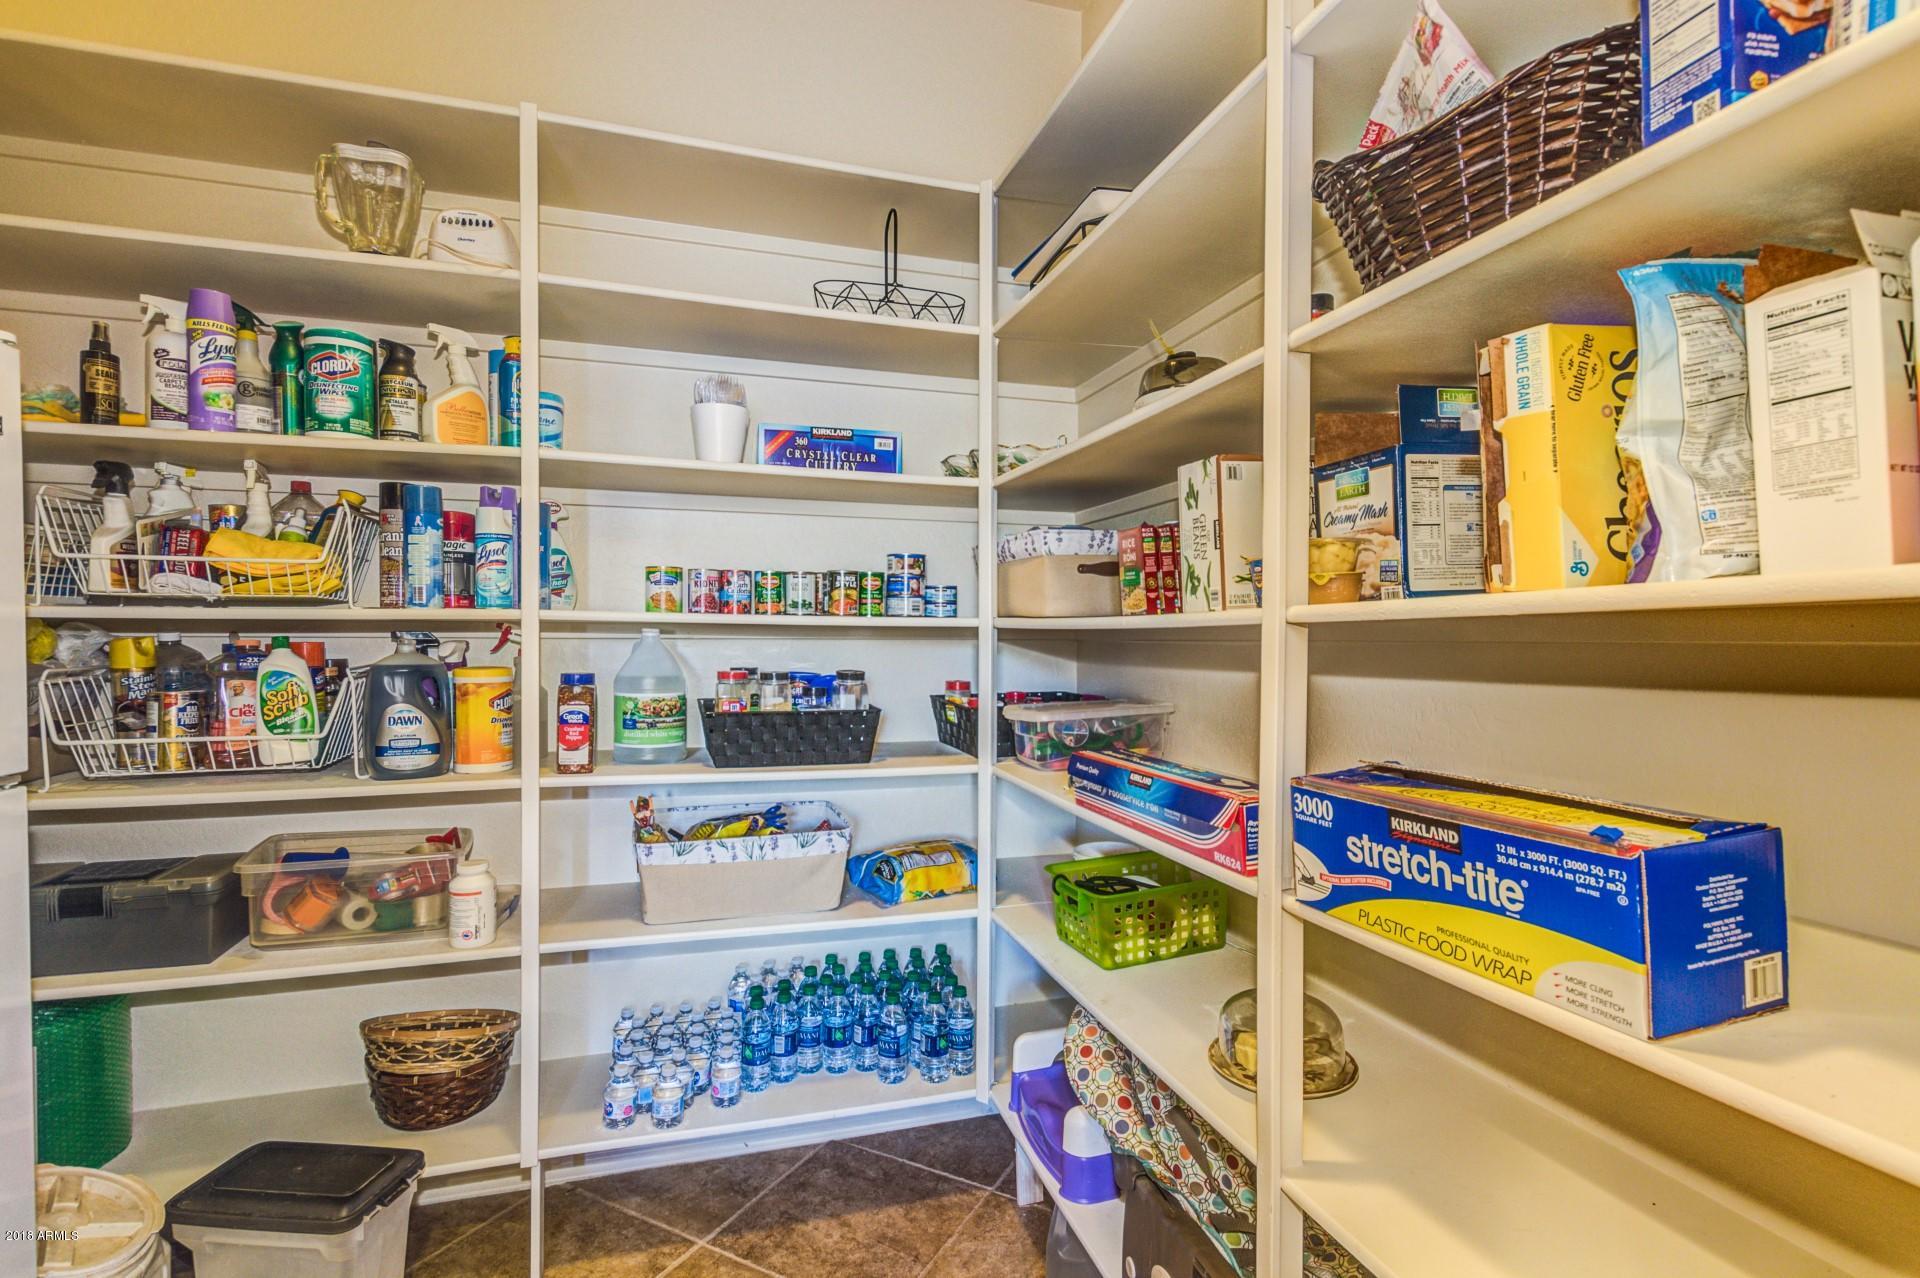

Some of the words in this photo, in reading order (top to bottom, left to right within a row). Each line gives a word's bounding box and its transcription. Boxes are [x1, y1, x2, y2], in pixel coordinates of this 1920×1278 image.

[1361, 122, 1381, 147] Pack
[1766, 304, 1813, 319] Nutrition
[1815, 293, 1848, 305] Facts
[198, 337, 236, 360] Lyso
[1515, 333, 1529, 374] WHOLE
[1577, 333, 1596, 359] Free
[311, 359, 355, 375] CLOROX
[164, 383, 187, 391] REMOV
[309, 381, 359, 393] DISINFECTING
[381, 379, 414, 388] UST-OLEUM
[1567, 360, 1590, 403] Gluten
[320, 387, 345, 396] WIPES
[381, 386, 416, 397] NIVERSAL
[1517, 375, 1531, 411] GRAIN
[794, 436, 808, 446] 360
[812, 427, 853, 437] KIRKLAND
[786, 448, 836, 462] CRYSTAL
[841, 451, 877, 463] CLEAR
[806, 458, 858, 472] CUTLERY
[1340, 486, 1366, 497] EARTH
[1323, 511, 1359, 531] Creamy
[1359, 501, 1389, 520] Mash
[176, 529, 191, 551] STEEL
[382, 527, 404, 542] rani
[1122, 538, 1136, 548] RICE
[1192, 517, 1201, 560] BEANS
[1199, 513, 1208, 561] GREEN
[383, 542, 403, 556] lean
[477, 541, 508, 563] Lysol
[1123, 553, 1137, 563] RONI
[551, 556, 567, 568] sol
[693, 579, 720, 588] KIDNE
[121, 674, 153, 686] Stainl
[129, 682, 154, 692] Ste
[266, 680, 301, 706] Soft
[228, 707, 256, 718] Cle
[263, 692, 309, 721] Scrub
[494, 700, 513, 711] CLO
[387, 715, 423, 727] DAWN
[562, 712, 584, 721] Great
[1088, 765, 1100, 777] Quality
[1293, 792, 1334, 822] 3000
[1295, 812, 1318, 826] SQUARE
[1318, 817, 1333, 829] FEET
[1390, 815, 1460, 845] KIRKLAND
[1213, 850, 1242, 872] RK624
[1495, 843, 1506, 854] 12
[1526, 850, 1548, 863] 3000
[1548, 855, 1562, 867] FT.
[1562, 858, 1589, 873] (3000
[1590, 864, 1607, 878] SQ.
[1607, 868, 1628, 883] FT.)
[1346, 833, 1526, 912] stretch-tite
[1496, 854, 1519, 867] 30.48
[1519, 860, 1532, 871] cm
[1539, 864, 1564, 879] 914.4
[1564, 872, 1575, 881] m
[1575, 873, 1605, 889] (278.7
[1357, 908, 1416, 943] PLASTIC
[1417, 931, 1468, 963] FOOD
[1471, 951, 1534, 986] WRAP
[1436, 925, 1492, 953] PROFESSIONAL
[1492, 945, 1530, 966] QUALITY
[1564, 975, 1588, 989] MORE
[1588, 983, 1614, 998] CLING
[1565, 986, 1588, 999] MORE
[1590, 994, 1626, 1013] STRETCH
[1566, 997, 1589, 1011] MORE
[1591, 1006, 1633, 1028] STRENGTH
